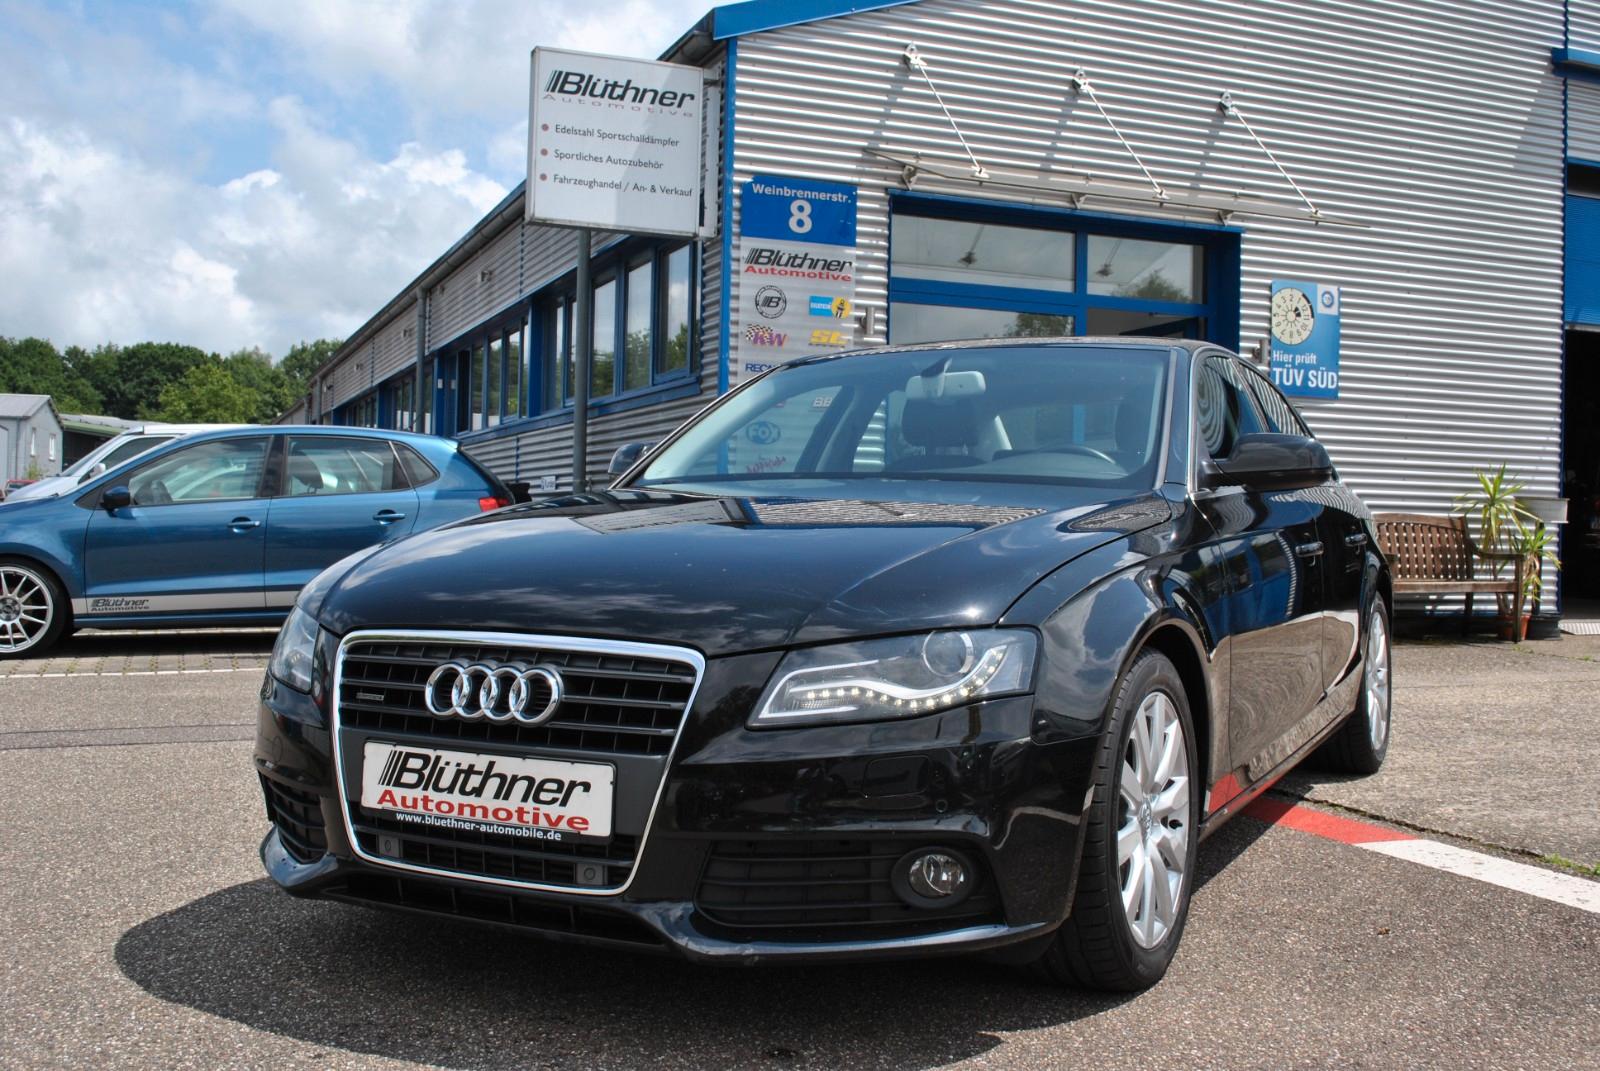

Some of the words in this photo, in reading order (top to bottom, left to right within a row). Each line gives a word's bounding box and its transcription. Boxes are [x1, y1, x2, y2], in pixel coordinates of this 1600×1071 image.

[552, 70, 695, 108] Blüthner
[543, 94, 693, 118] Automotive
[555, 124, 595, 138] Edelstahl
[597, 129, 680, 148] Sportschalldämpfer
[554, 149, 604, 164] Sportliches
[606, 155, 664, 170] Autozubehör
[553, 174, 622, 190] Fahrzeughandel
[632, 183, 648, 193] An-
[650, 184, 657, 193] &
[659, 185, 693, 197] Verkauf
[752, 183, 852, 203] Weinbrennerstr.
[788, 199, 812, 234] 8
[750, 248, 853, 272] Blüthner
[744, 265, 852, 282] Automotive
[1273, 350, 1293, 362] Hier
[1295, 353, 1317, 365] prüft
[1273, 364, 1304, 387] TÜV
[1308, 367, 1338, 389] SÜD
[384, 750, 592, 807] Blüthner
[376, 789, 590, 832] Automotive
[396, 812, 562, 842] www.bluethner-automobile.de
